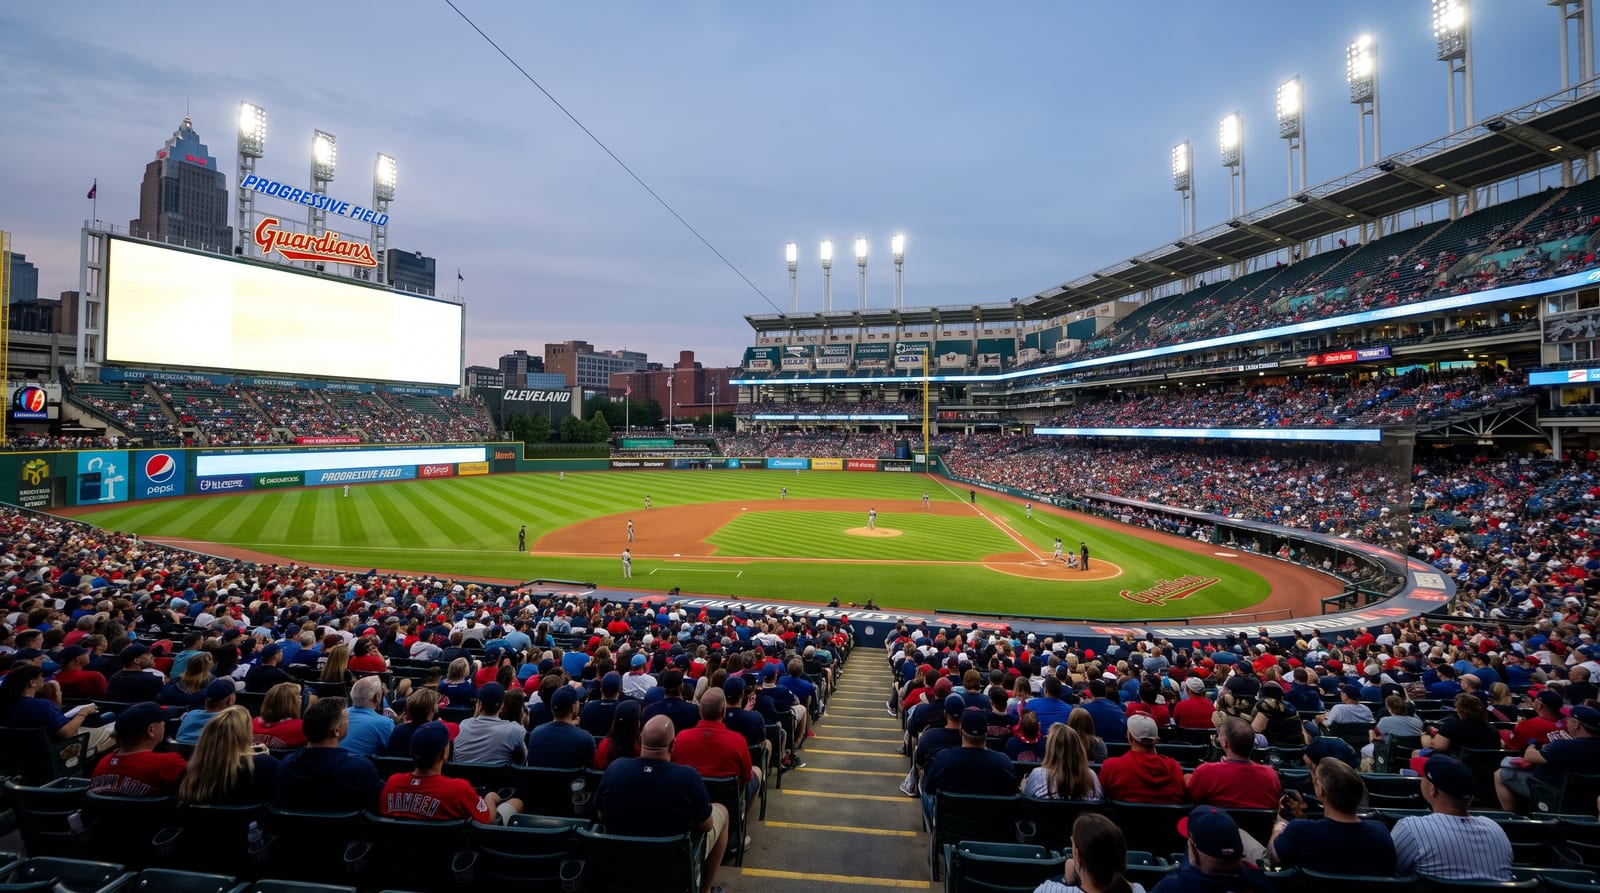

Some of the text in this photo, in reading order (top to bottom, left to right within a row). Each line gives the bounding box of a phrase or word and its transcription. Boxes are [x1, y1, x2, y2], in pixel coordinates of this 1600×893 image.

[241, 174, 389, 227] PROGRESSIVE FIELD
[254, 217, 377, 267] Guardians
[503, 389, 571, 403] CLEVELAND
[379, 468, 402, 478] FIELD
[147, 484, 174, 496] pepsi
